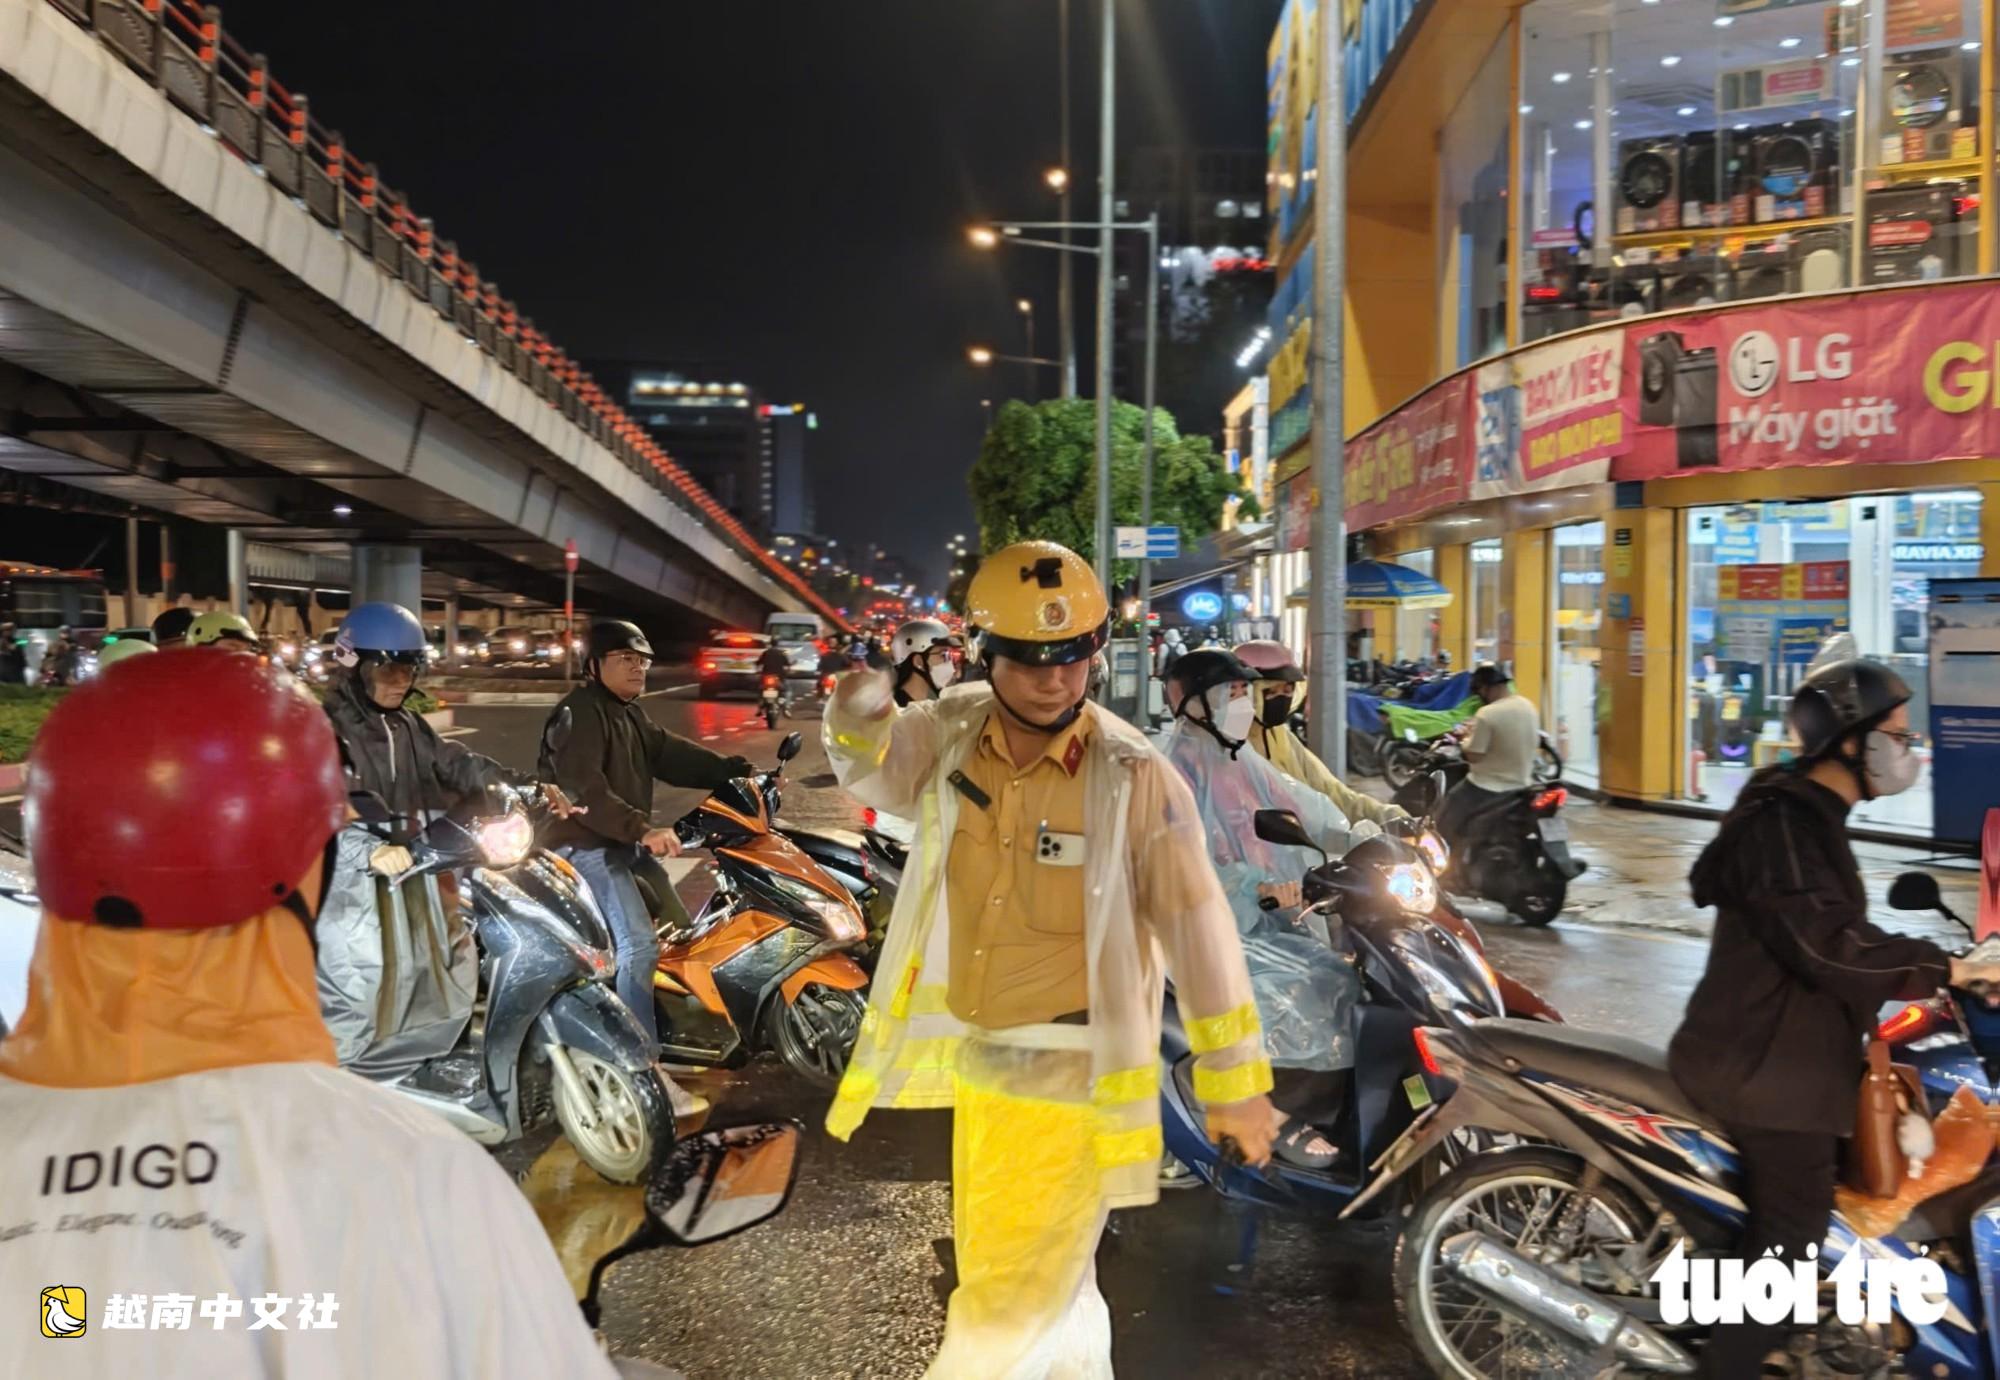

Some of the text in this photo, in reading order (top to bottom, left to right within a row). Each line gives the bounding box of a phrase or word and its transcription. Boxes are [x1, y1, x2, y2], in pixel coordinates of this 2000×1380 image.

[1788, 333, 1851, 382] LG
[1729, 396, 1897, 451] Máy giặt
[40, 1141, 218, 1196] IDIGO
